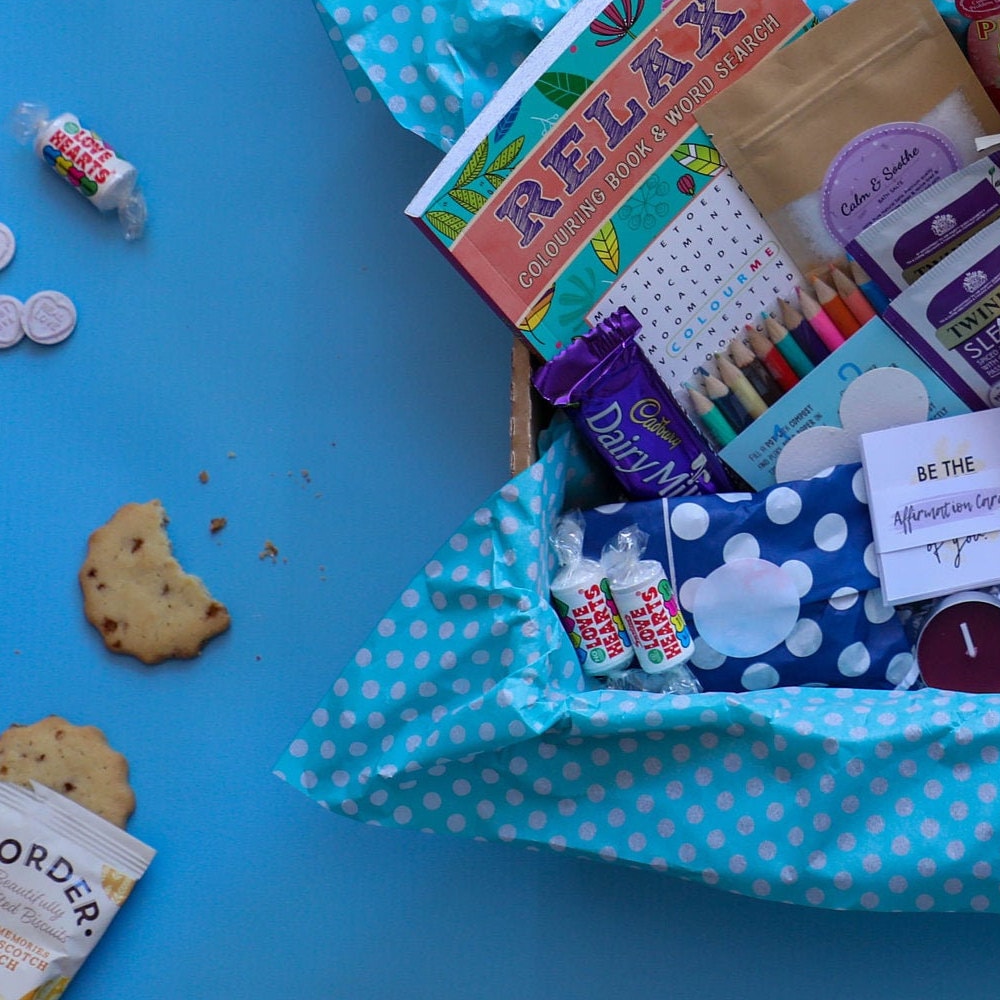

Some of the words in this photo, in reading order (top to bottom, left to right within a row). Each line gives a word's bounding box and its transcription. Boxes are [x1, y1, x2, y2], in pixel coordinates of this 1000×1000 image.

[49, 128, 111, 185] HEARTS
[73, 129, 113, 164] LOVE
[517, 188, 606, 291] COLOURING
[604, 136, 653, 192] BOOK
[652, 124, 669, 143] &
[664, 76, 716, 128] WORD
[713, 12, 782, 80] SEARCH
[840, 191, 872, 217] Calm
[870, 177, 882, 193] &
[881, 145, 920, 182] Soothe
[585, 400, 660, 473] Dairy
[629, 398, 682, 450] Cadbury
[916, 462, 939, 483] BE
[941, 455, 976, 479] THE
[893, 500, 974, 536] Affirmation
[572, 604, 603, 650] LOVE
[584, 583, 625, 660] HEARTS
[629, 606, 661, 651] LOVE
[641, 586, 683, 661] HEARTS
[0, 838, 101, 927] ORDER
[20, 905, 70, 944] Biscuits
